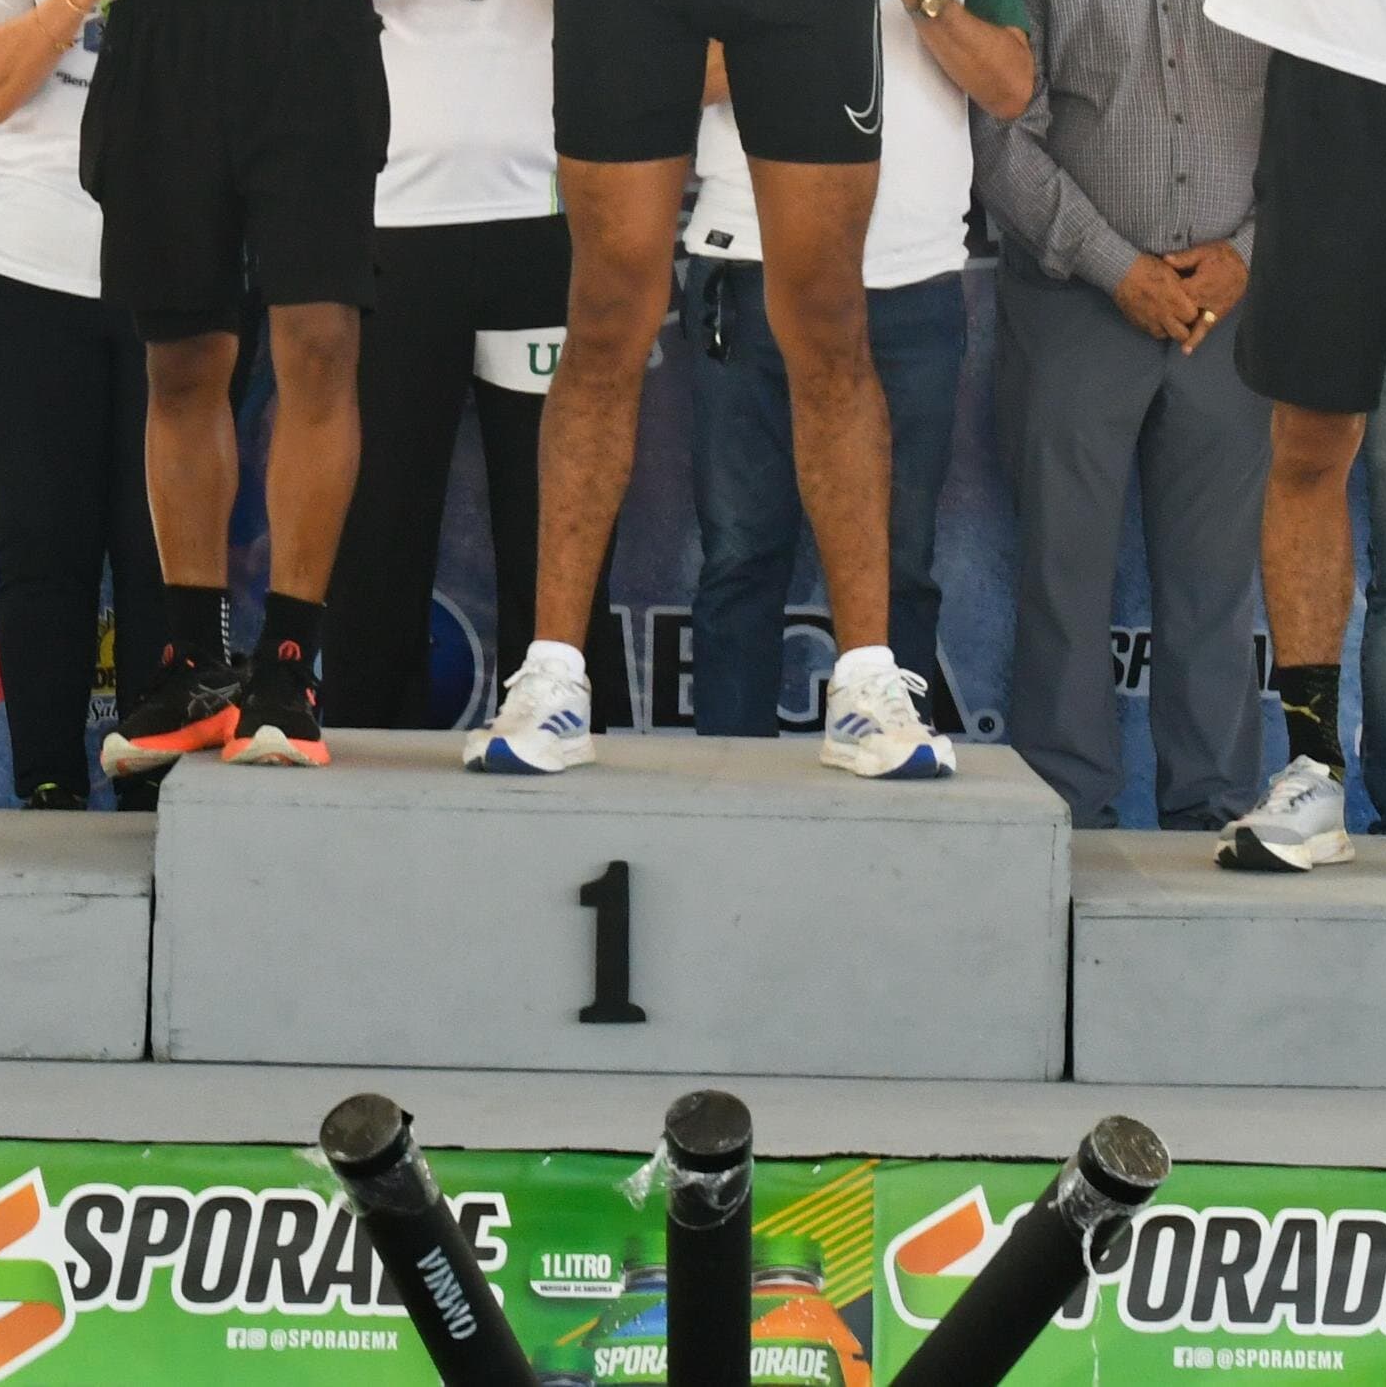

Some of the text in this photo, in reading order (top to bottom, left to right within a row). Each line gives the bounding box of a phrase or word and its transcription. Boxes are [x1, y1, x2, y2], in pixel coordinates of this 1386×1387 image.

[577, 860, 648, 1026] 1
[65, 1194, 503, 1309] SPORAE
[553, 1253, 612, 1280] LITRO
[270, 1326, 398, 1352] @SPORADEMX
[594, 1344, 668, 1377] SPORA
[751, 1346, 829, 1380] ORADE
[1216, 1345, 1345, 1372] @SPORADEMX
